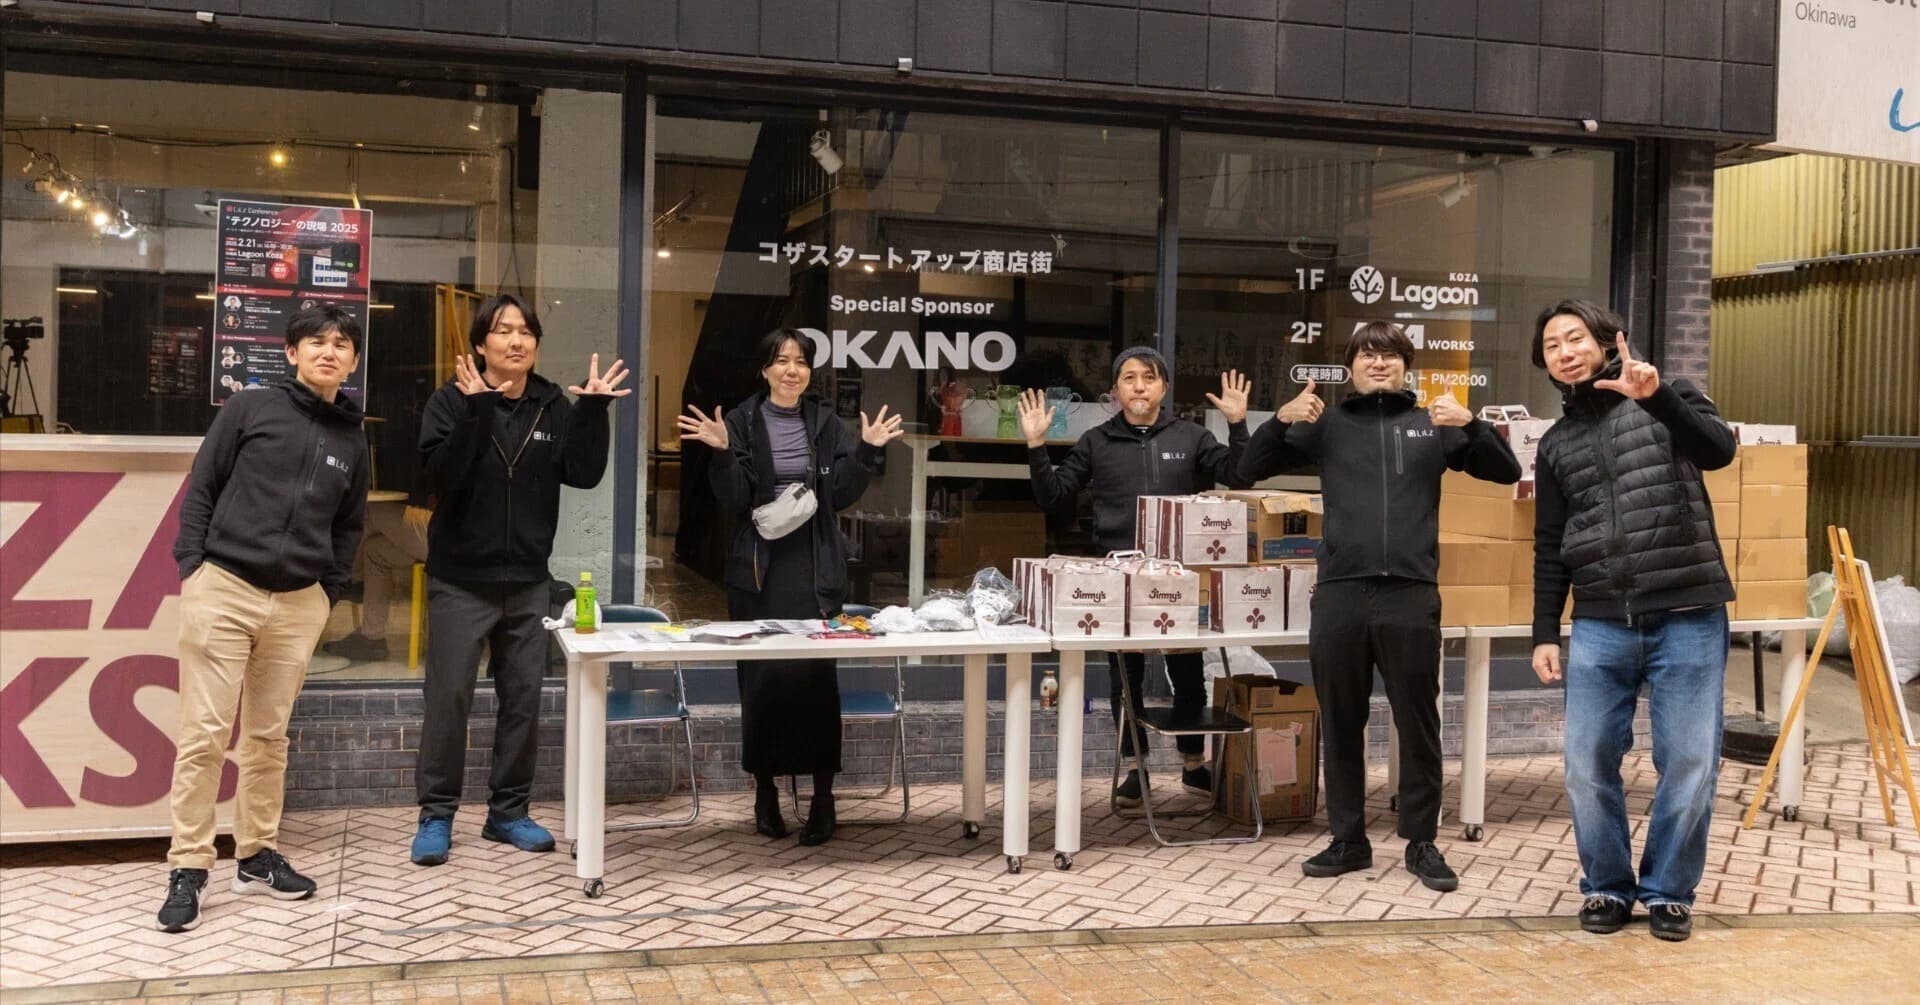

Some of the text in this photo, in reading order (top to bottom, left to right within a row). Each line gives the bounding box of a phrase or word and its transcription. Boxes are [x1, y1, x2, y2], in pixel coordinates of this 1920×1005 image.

[1795, 2, 1857, 29] Okinawa
[330, 222, 359, 233] 2025
[237, 250, 265, 259] Lagoon
[758, 242, 1052, 274] コザスタートアップ商店街
[1449, 272, 1479, 283] KOZA
[1295, 268, 1479, 311] 1F Lagoon
[830, 294, 995, 316] Special Sponsor
[1290, 322, 1475, 351] 2F WORKS
[1296, 367, 1344, 382] 営業時間
[1201, 515, 1233, 530] Jimmy's
[1072, 587, 1107, 603] Jimmy's
[1148, 587, 1183, 603] Jimmy's
[1241, 583, 1272, 598] Jimmy's
